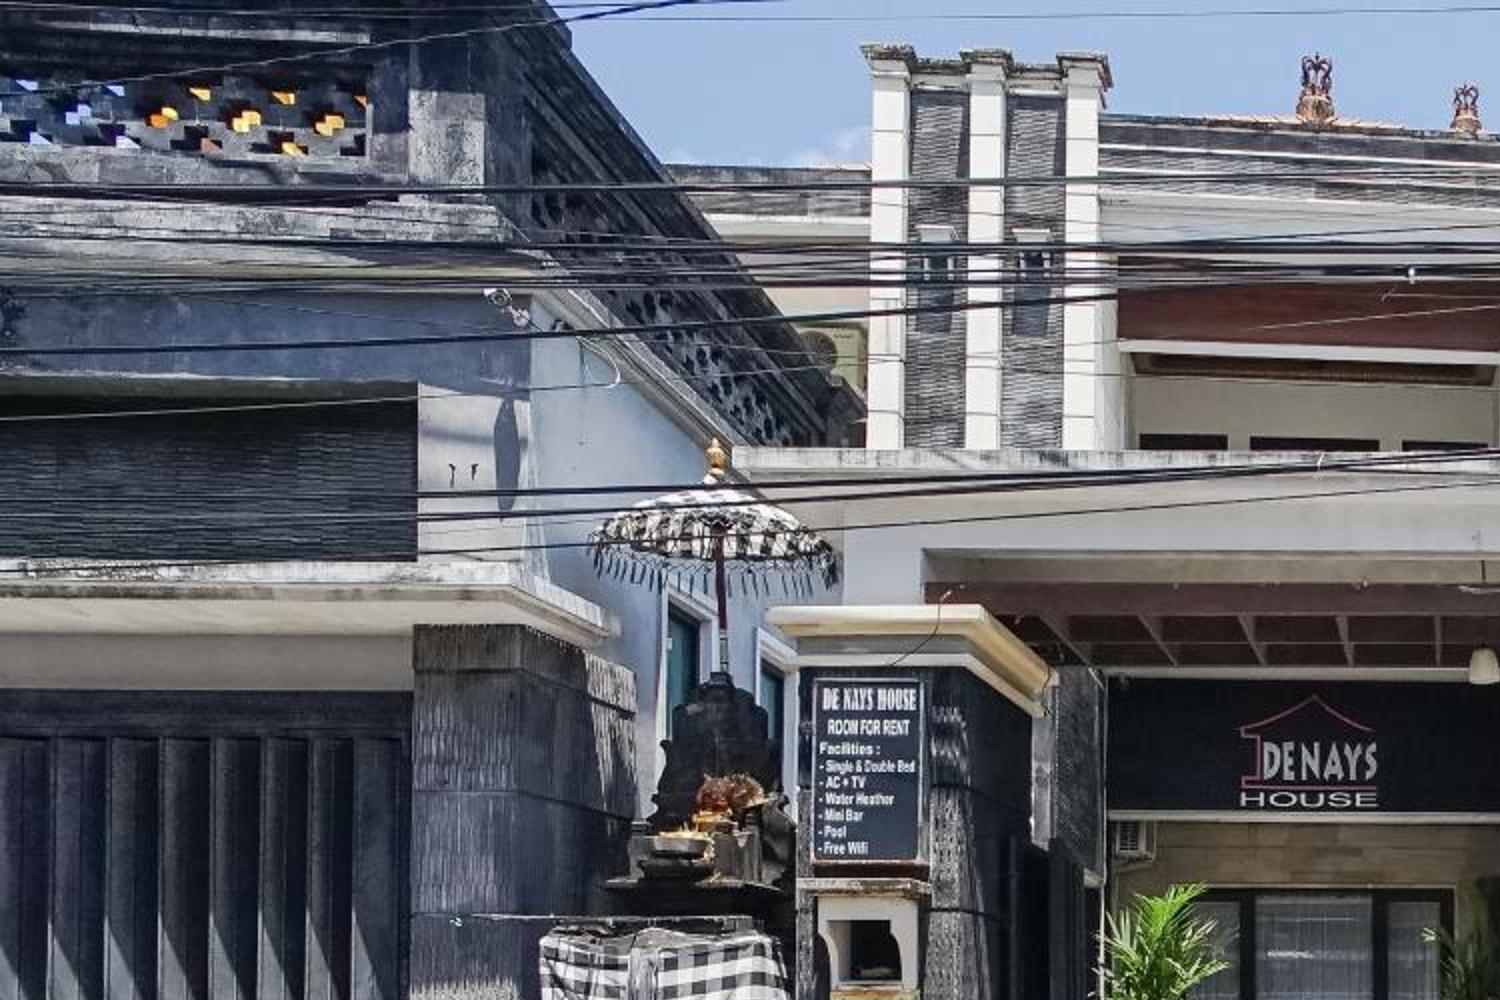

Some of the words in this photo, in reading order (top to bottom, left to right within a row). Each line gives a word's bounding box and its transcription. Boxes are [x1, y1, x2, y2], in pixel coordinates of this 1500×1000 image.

[822, 688, 840, 711] DE
[843, 688, 873, 711] NAYS
[877, 688, 917, 711] HOUSE
[827, 719, 858, 735] ROOM
[860, 719, 881, 735] FOR
[883, 719, 911, 735] RENT
[825, 759, 853, 774] Single
[864, 760, 896, 773] Double
[897, 760, 915, 773] Bed
[825, 776, 841, 789] AC
[851, 776, 867, 789] TV
[825, 792, 854, 805] Water
[1240, 791, 1378, 808] HOUSE
[824, 809, 844, 821] Mini
[845, 809, 864, 821] Bar
[823, 825, 847, 838] Pool
[823, 841, 846, 854] Free
